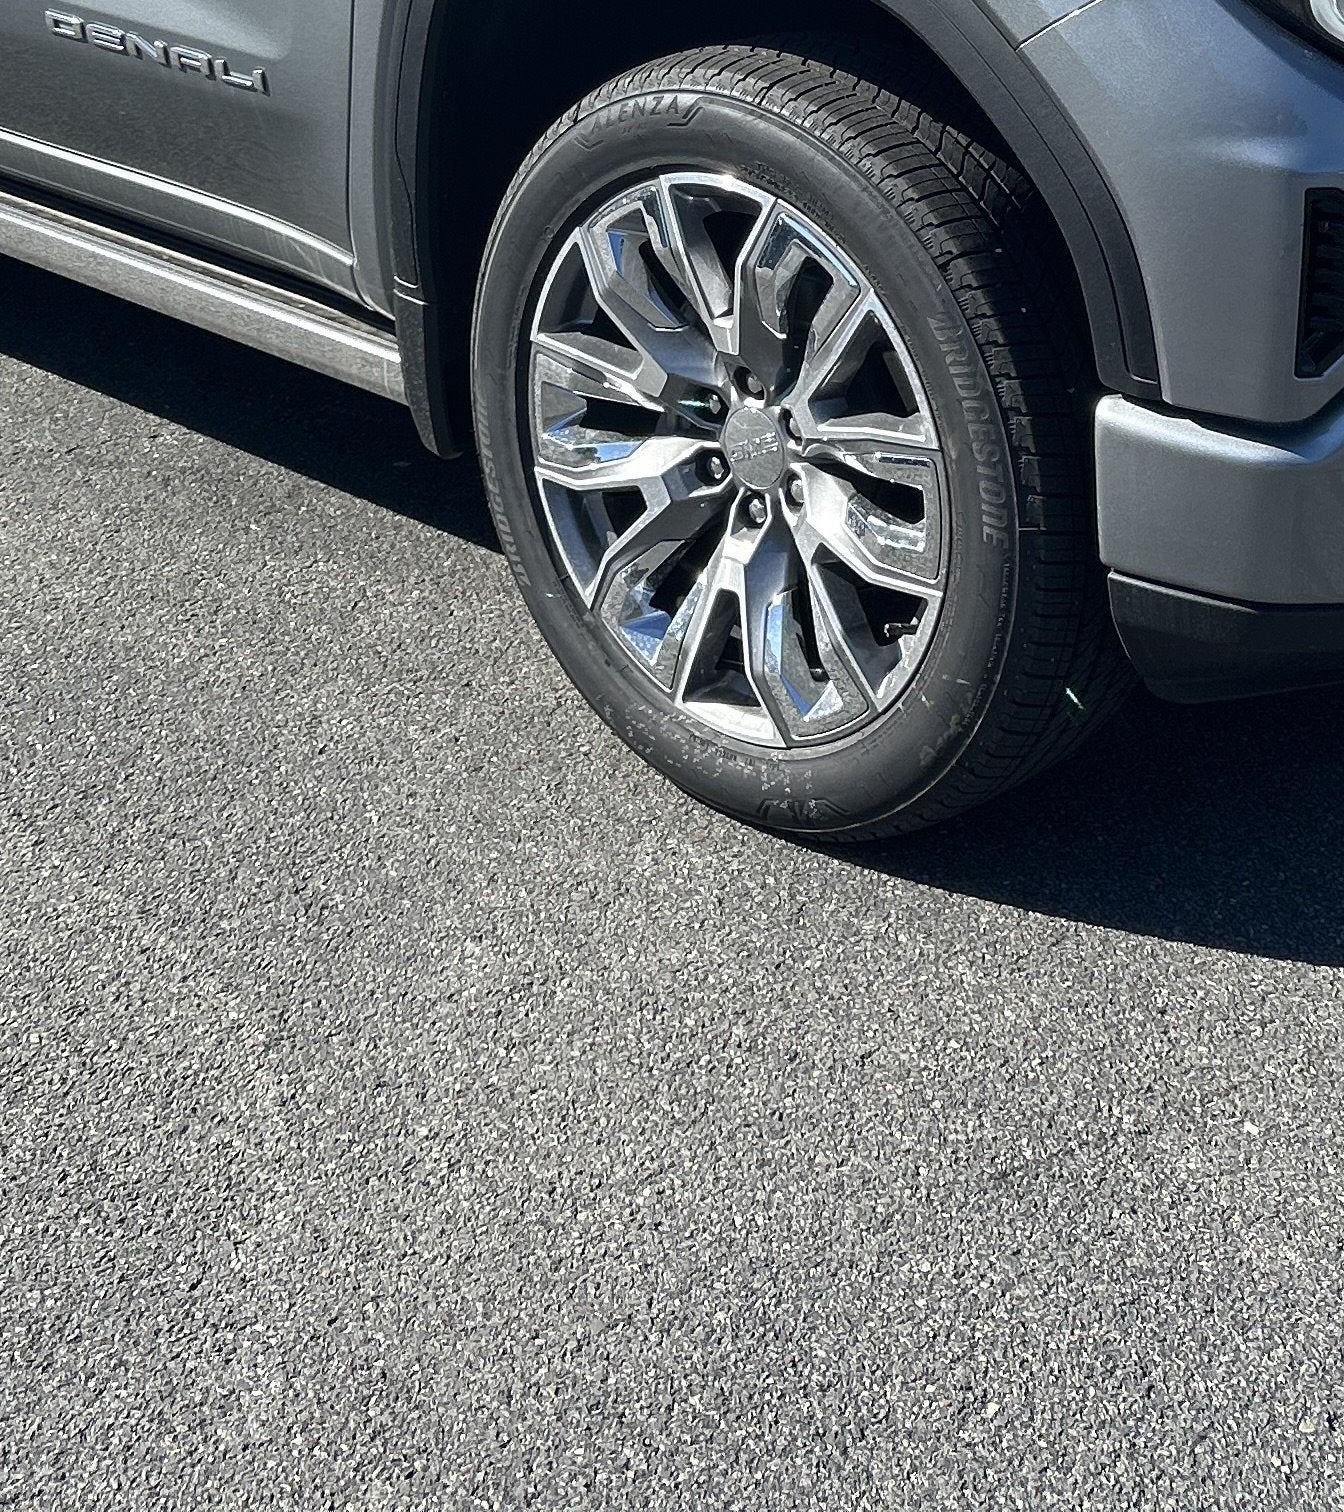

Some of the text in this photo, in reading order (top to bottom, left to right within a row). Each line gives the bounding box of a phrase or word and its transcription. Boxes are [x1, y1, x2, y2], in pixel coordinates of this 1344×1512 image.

[44, 7, 271, 97] DENALI
[590, 94, 680, 135] ALENZA
[927, 311, 1009, 548] BRIDGESTONE
